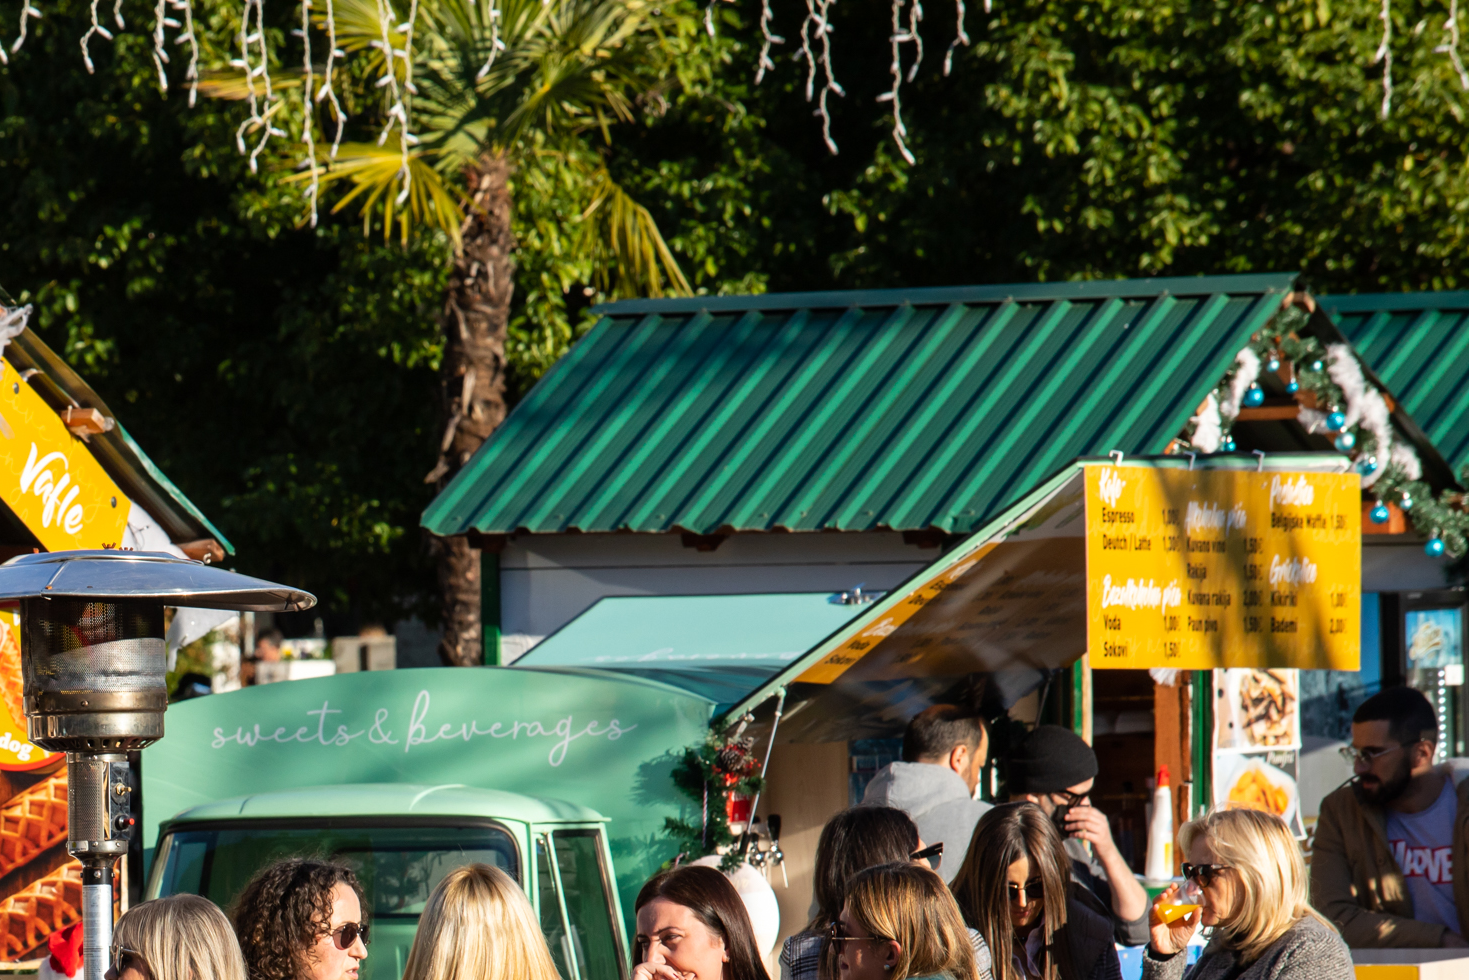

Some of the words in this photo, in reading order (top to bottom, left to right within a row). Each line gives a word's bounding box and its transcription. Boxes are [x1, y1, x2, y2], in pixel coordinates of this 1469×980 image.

[20, 442, 84, 535] Vafle
[1102, 507, 1136, 527] Espresso
[1103, 614, 1122, 631] Voda
[1103, 641, 1129, 658] Sokovi
[211, 701, 366, 748] sweets
[368, 708, 399, 745] &
[404, 690, 638, 767] beverages
[1388, 839, 1453, 885] MARVE
